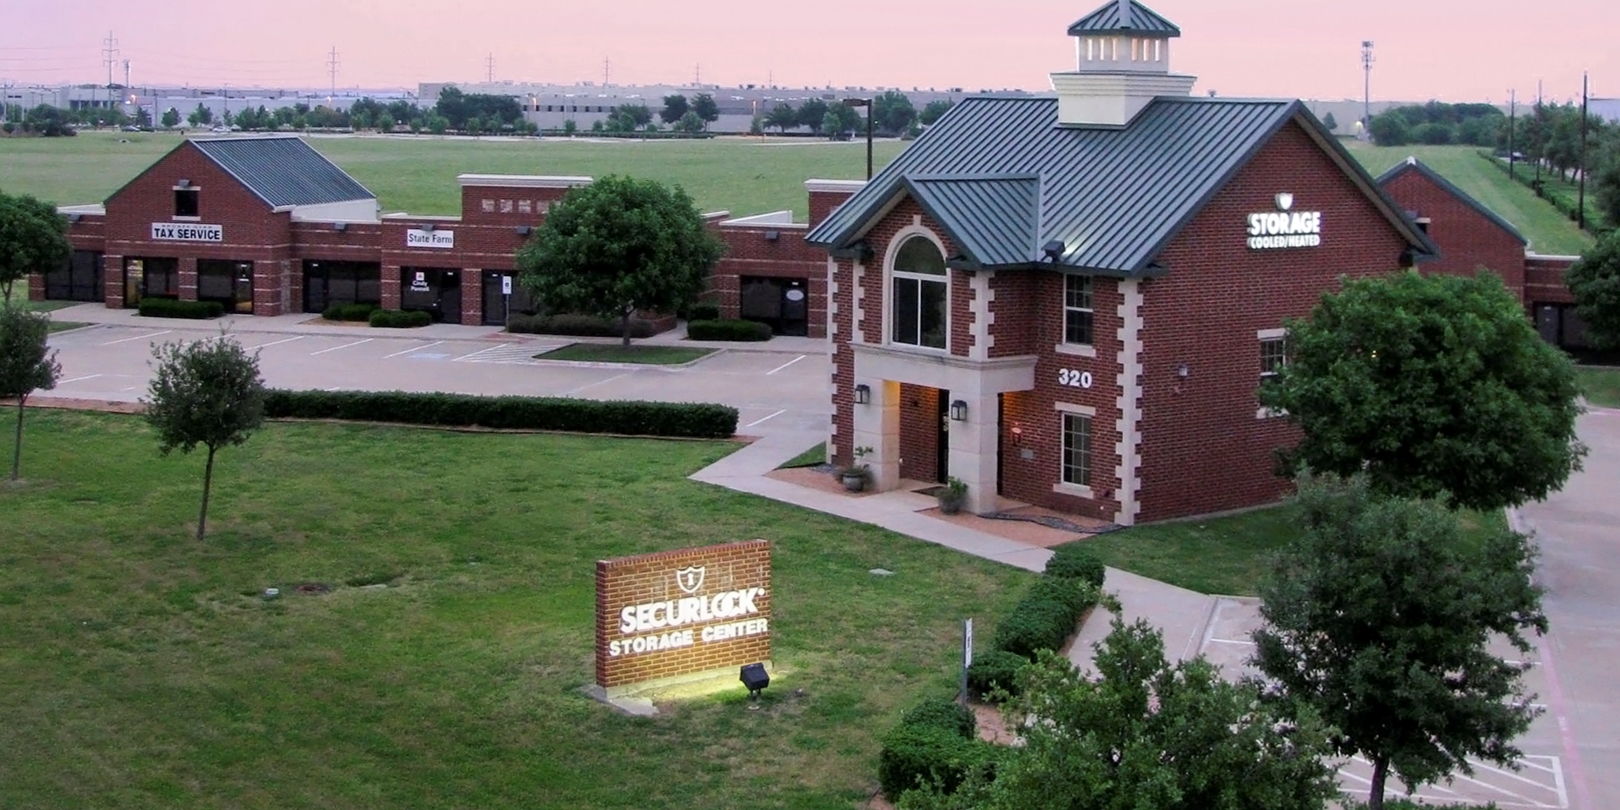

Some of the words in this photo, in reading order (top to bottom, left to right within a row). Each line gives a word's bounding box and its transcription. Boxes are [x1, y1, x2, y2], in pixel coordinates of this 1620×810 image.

[1248, 212, 1321, 235] STORAGE
[154, 228, 174, 238] TAX
[177, 229, 220, 240] SERVICE
[408, 233, 430, 243] State
[432, 234, 453, 244] Farm
[1248, 235, 1321, 249] COOLED/HEATED
[1058, 368, 1092, 388] 320
[619, 587, 765, 634] SECURLOCK
[609, 629, 694, 657] STORAGE
[701, 618, 768, 643] CENTER
